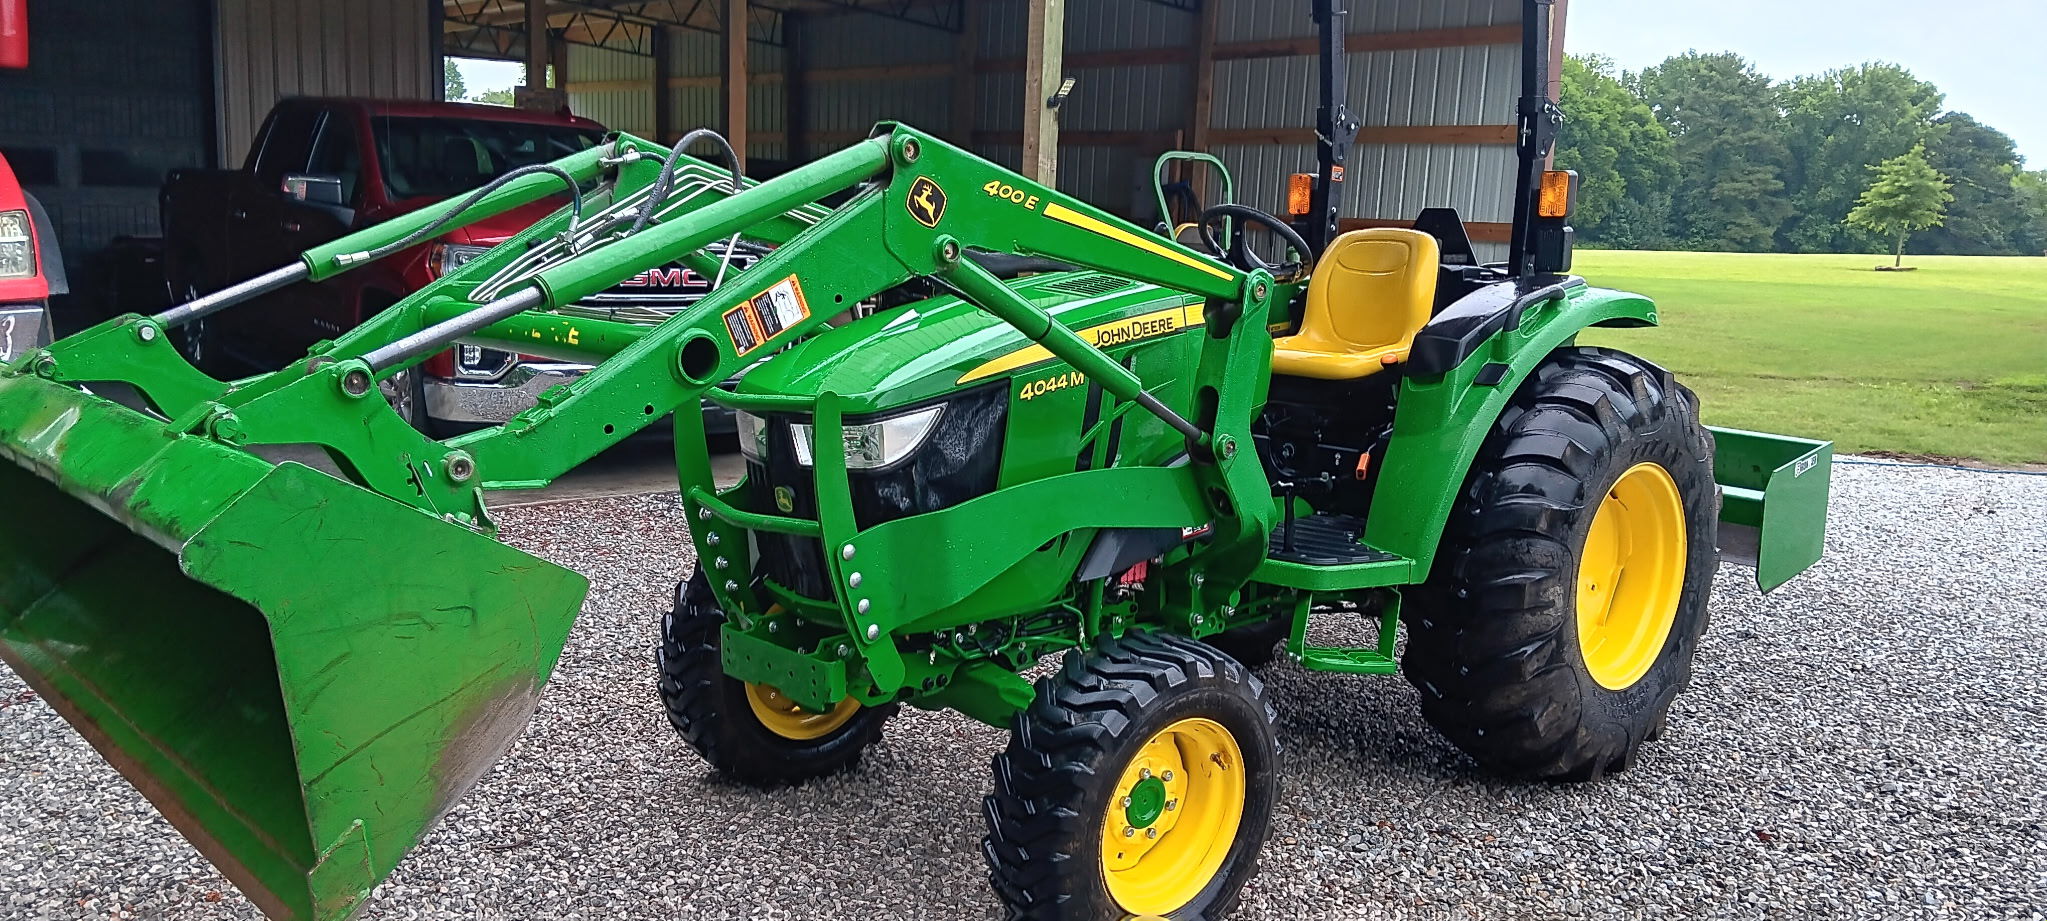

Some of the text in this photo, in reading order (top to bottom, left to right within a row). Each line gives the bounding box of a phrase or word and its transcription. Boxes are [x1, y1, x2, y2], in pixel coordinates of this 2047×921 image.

[982, 180, 1040, 211] 400 E
[620, 268, 708, 287] GMC
[1093, 317, 1174, 346] JOHN DEERE
[1019, 371, 1085, 401] 4044 M
